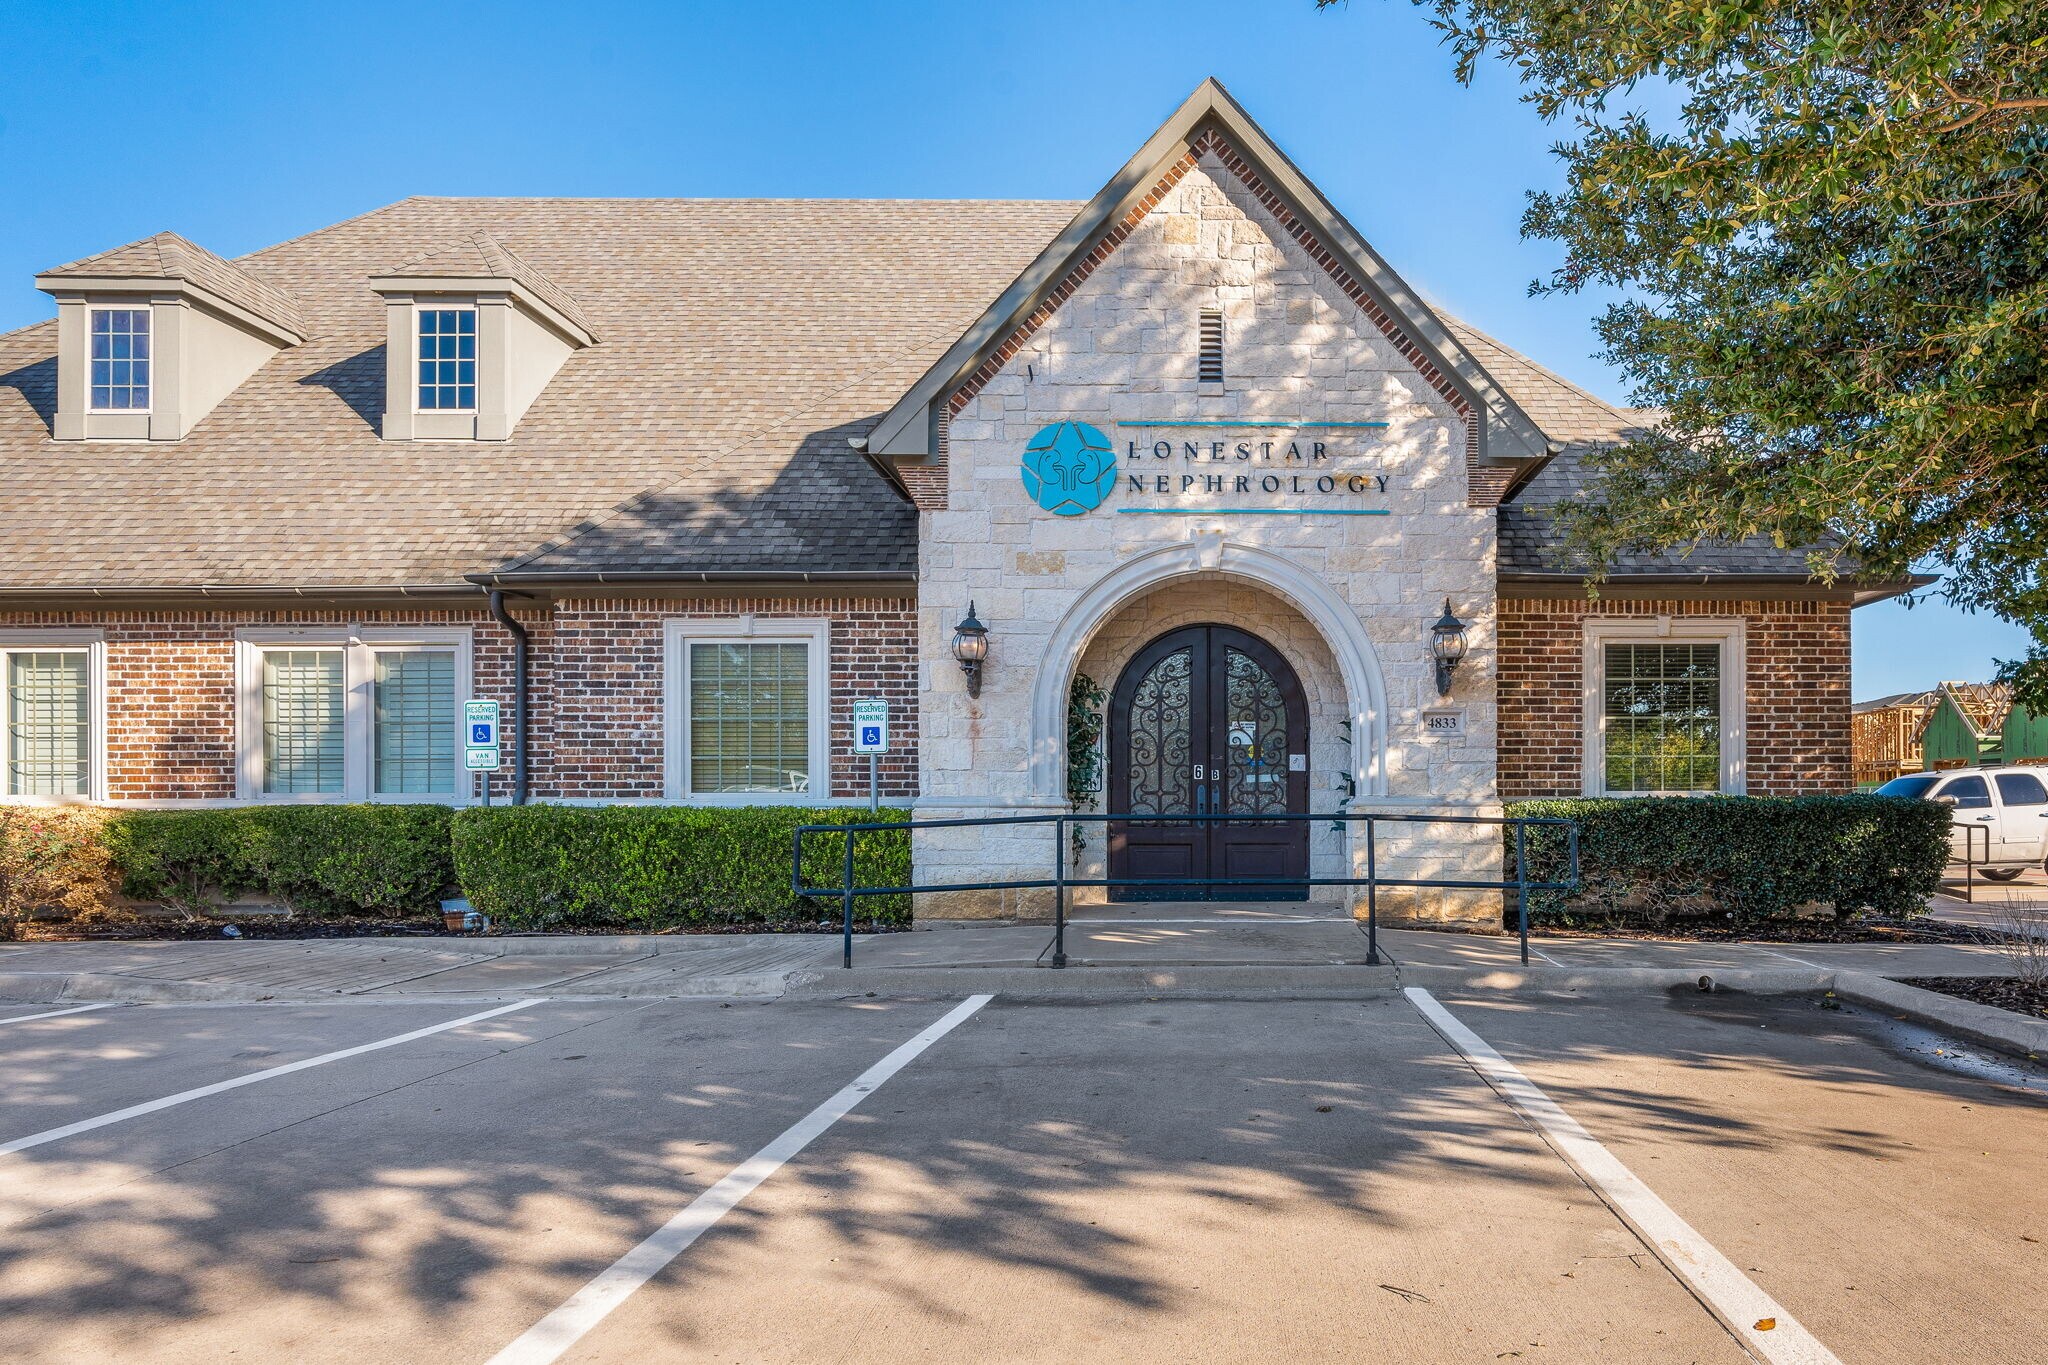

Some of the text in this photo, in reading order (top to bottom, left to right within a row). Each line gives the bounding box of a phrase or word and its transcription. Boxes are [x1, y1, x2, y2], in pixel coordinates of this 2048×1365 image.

[1128, 441, 1328, 461] LONESTAR
[1128, 474, 1391, 494] NEPHROLOGY
[1427, 717, 1457, 729] 4833
[1195, 765, 1202, 779] 6
